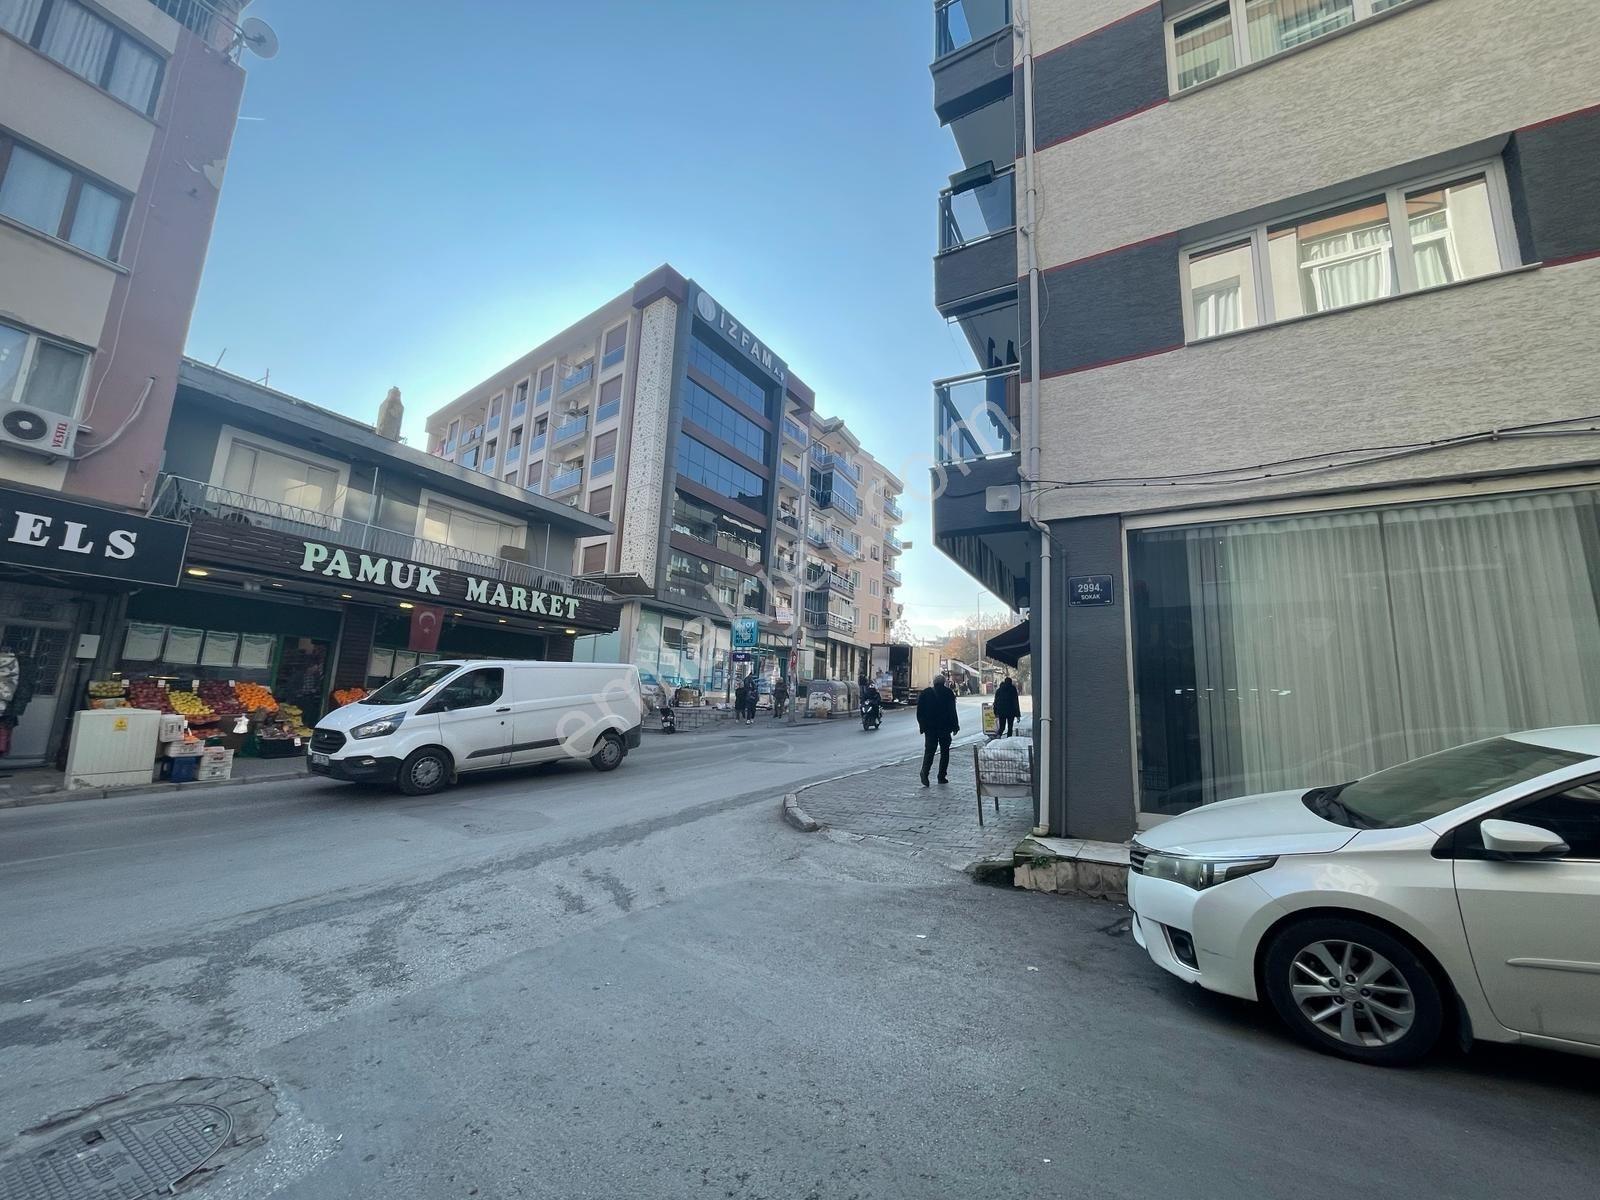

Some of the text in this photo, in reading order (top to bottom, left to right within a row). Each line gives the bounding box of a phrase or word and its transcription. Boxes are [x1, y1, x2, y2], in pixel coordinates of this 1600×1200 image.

[720, 309, 772, 369] İZFAM
[52, 422, 68, 447] VESTEL
[8, 511, 137, 560] ELS
[300, 541, 580, 619] PAMUK MARKET
[1077, 583, 1103, 593] 2994.
